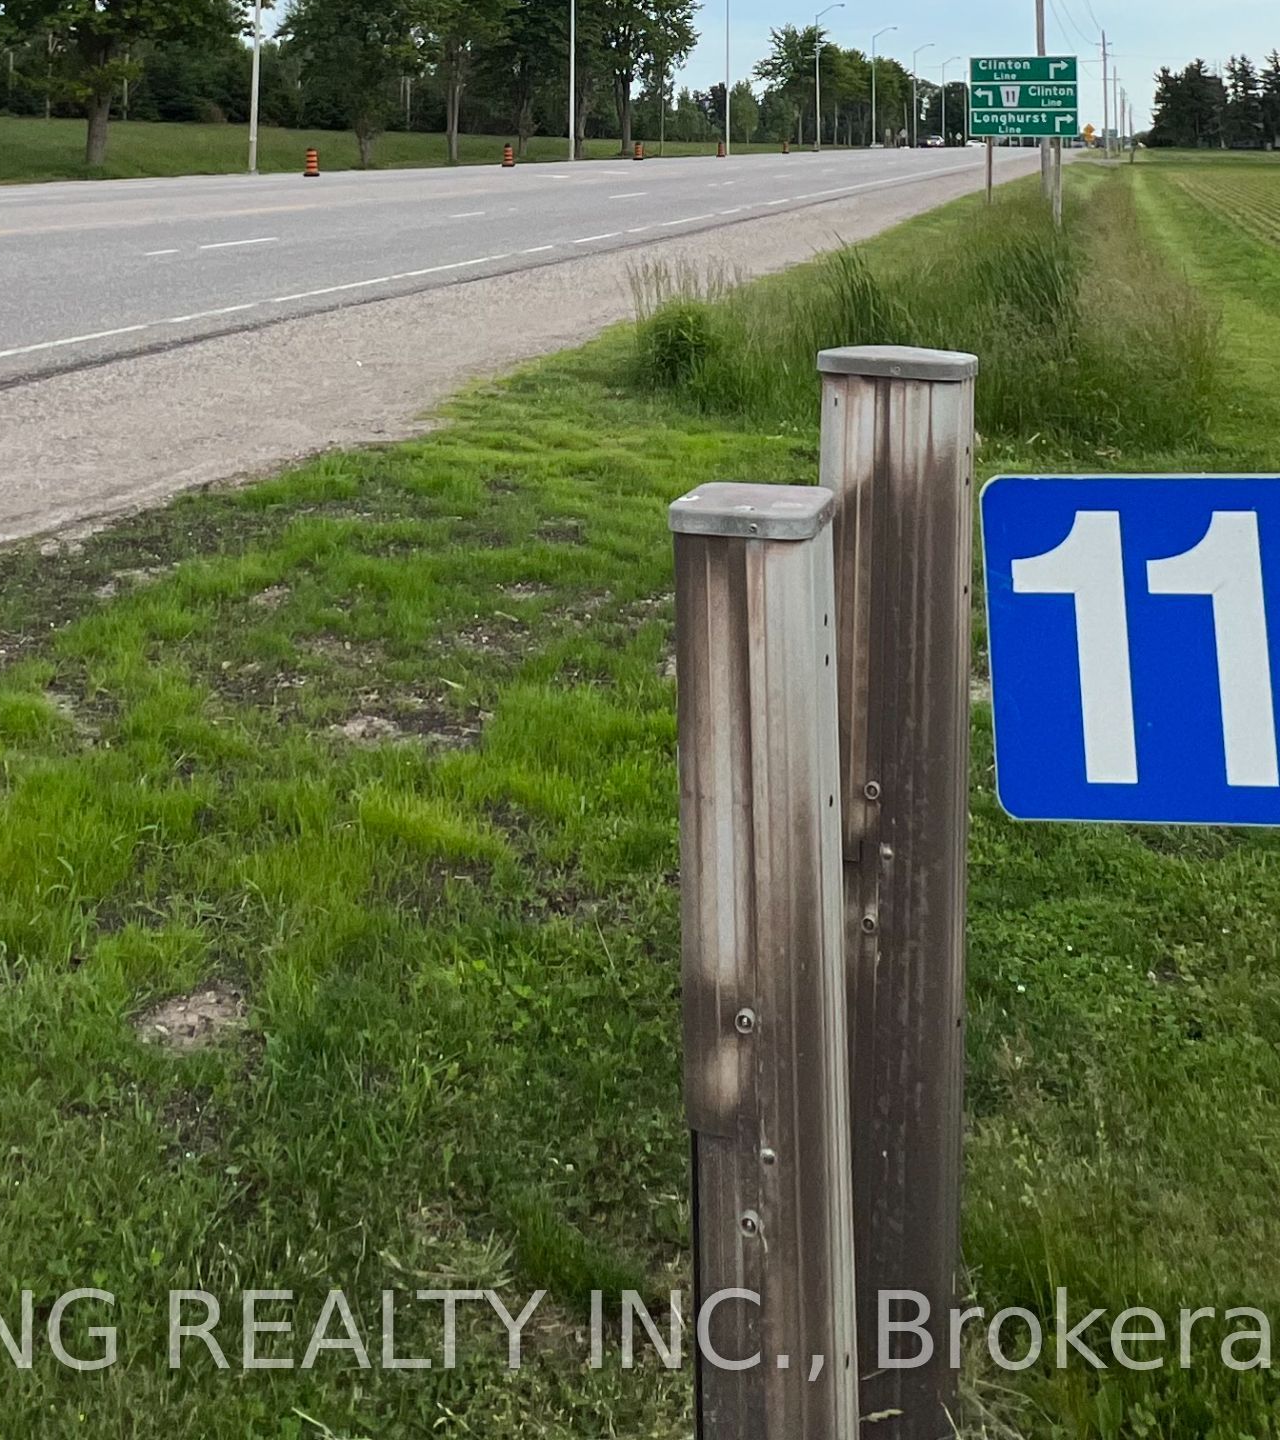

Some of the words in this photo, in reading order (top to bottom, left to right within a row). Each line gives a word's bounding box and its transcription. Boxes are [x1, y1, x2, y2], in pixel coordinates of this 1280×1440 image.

[979, 60, 1030, 70] Clinton
[994, 72, 1016, 80] Line
[1028, 86, 1074, 96] Clinton
[1005, 90, 1016, 103] 11
[974, 112, 1047, 125] Longhurst
